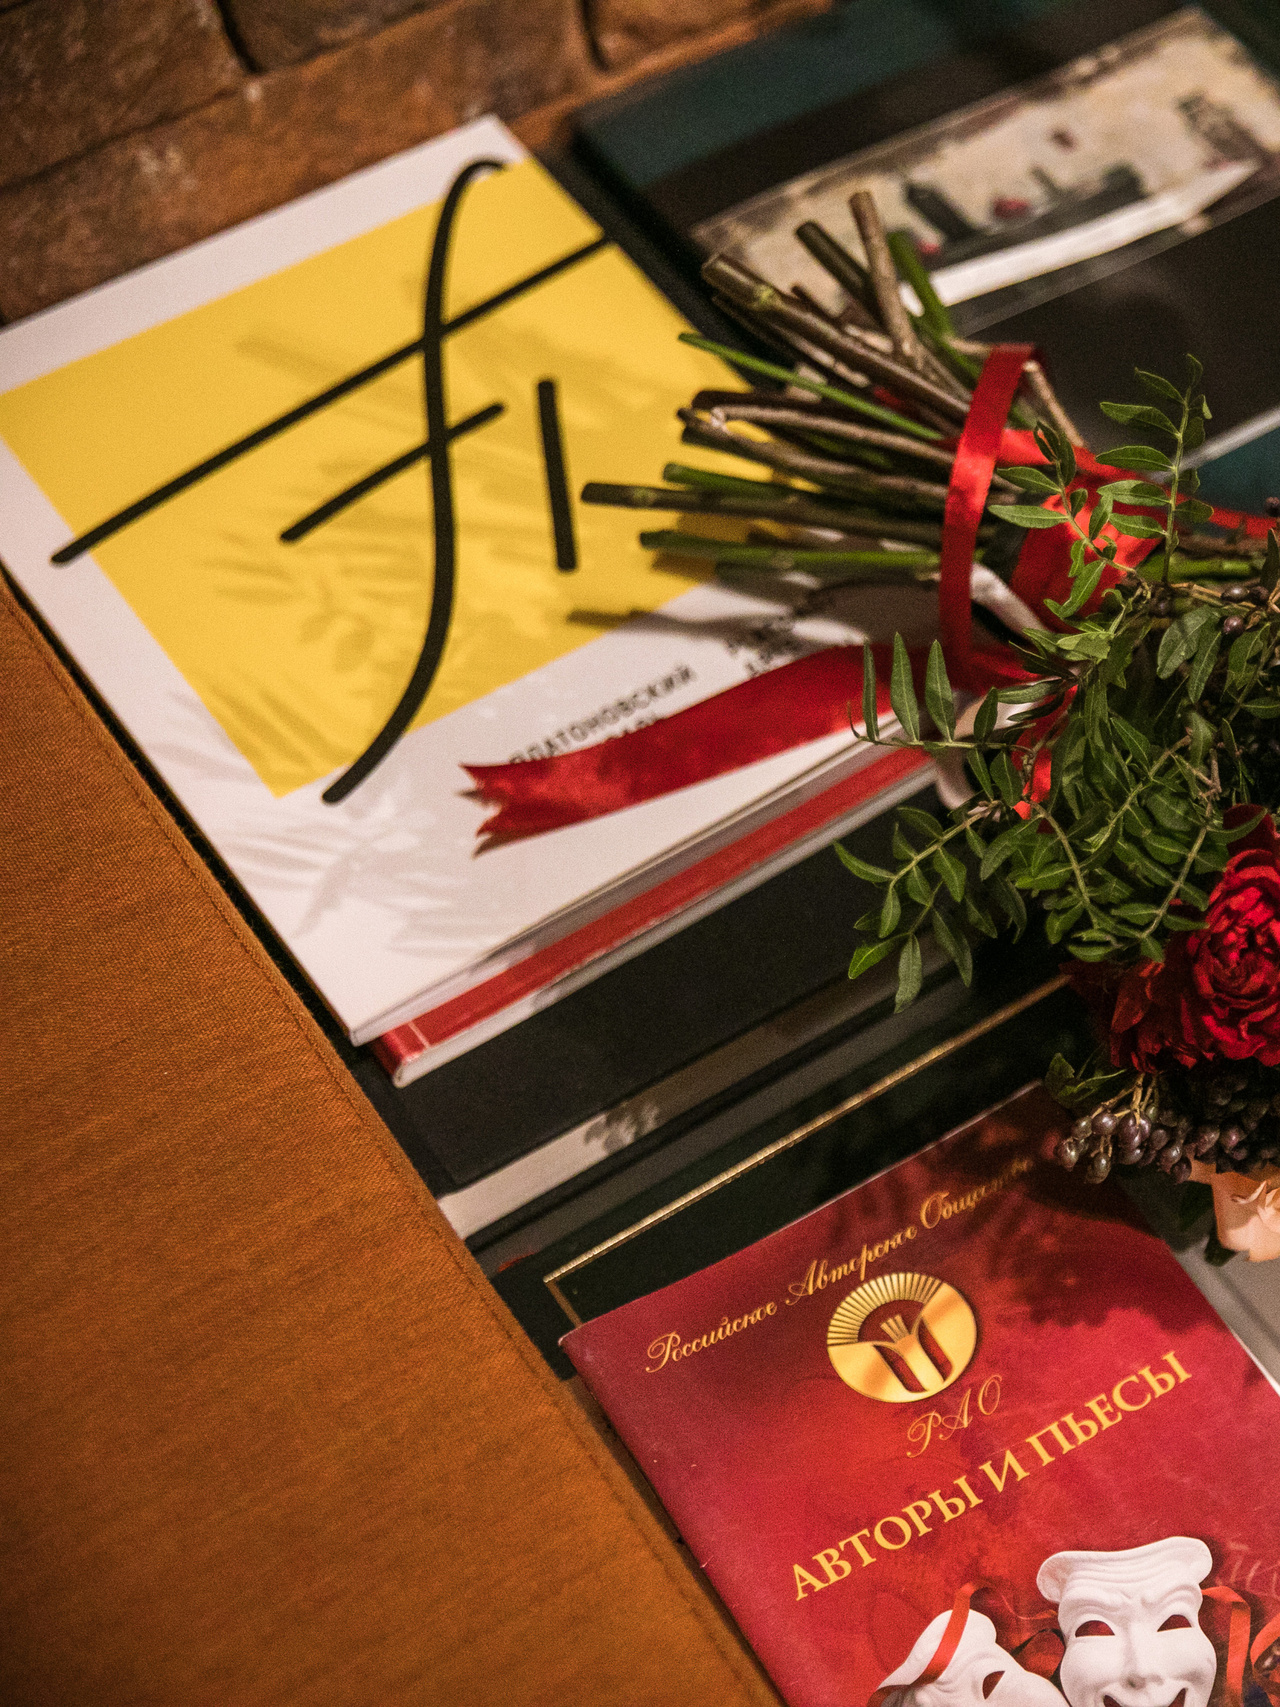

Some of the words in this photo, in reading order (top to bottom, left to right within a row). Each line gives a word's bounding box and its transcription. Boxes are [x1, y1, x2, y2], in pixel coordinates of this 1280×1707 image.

[645, 1299, 778, 1374] Российское
[785, 1227, 918, 1306] Авторское
[790, 1475, 984, 1601] АВТОРЫ
[979, 1449, 1031, 1493] И
[1025, 1350, 1193, 1467] ПЬЕСЫ
[906, 1374, 1003, 1458] РАО
